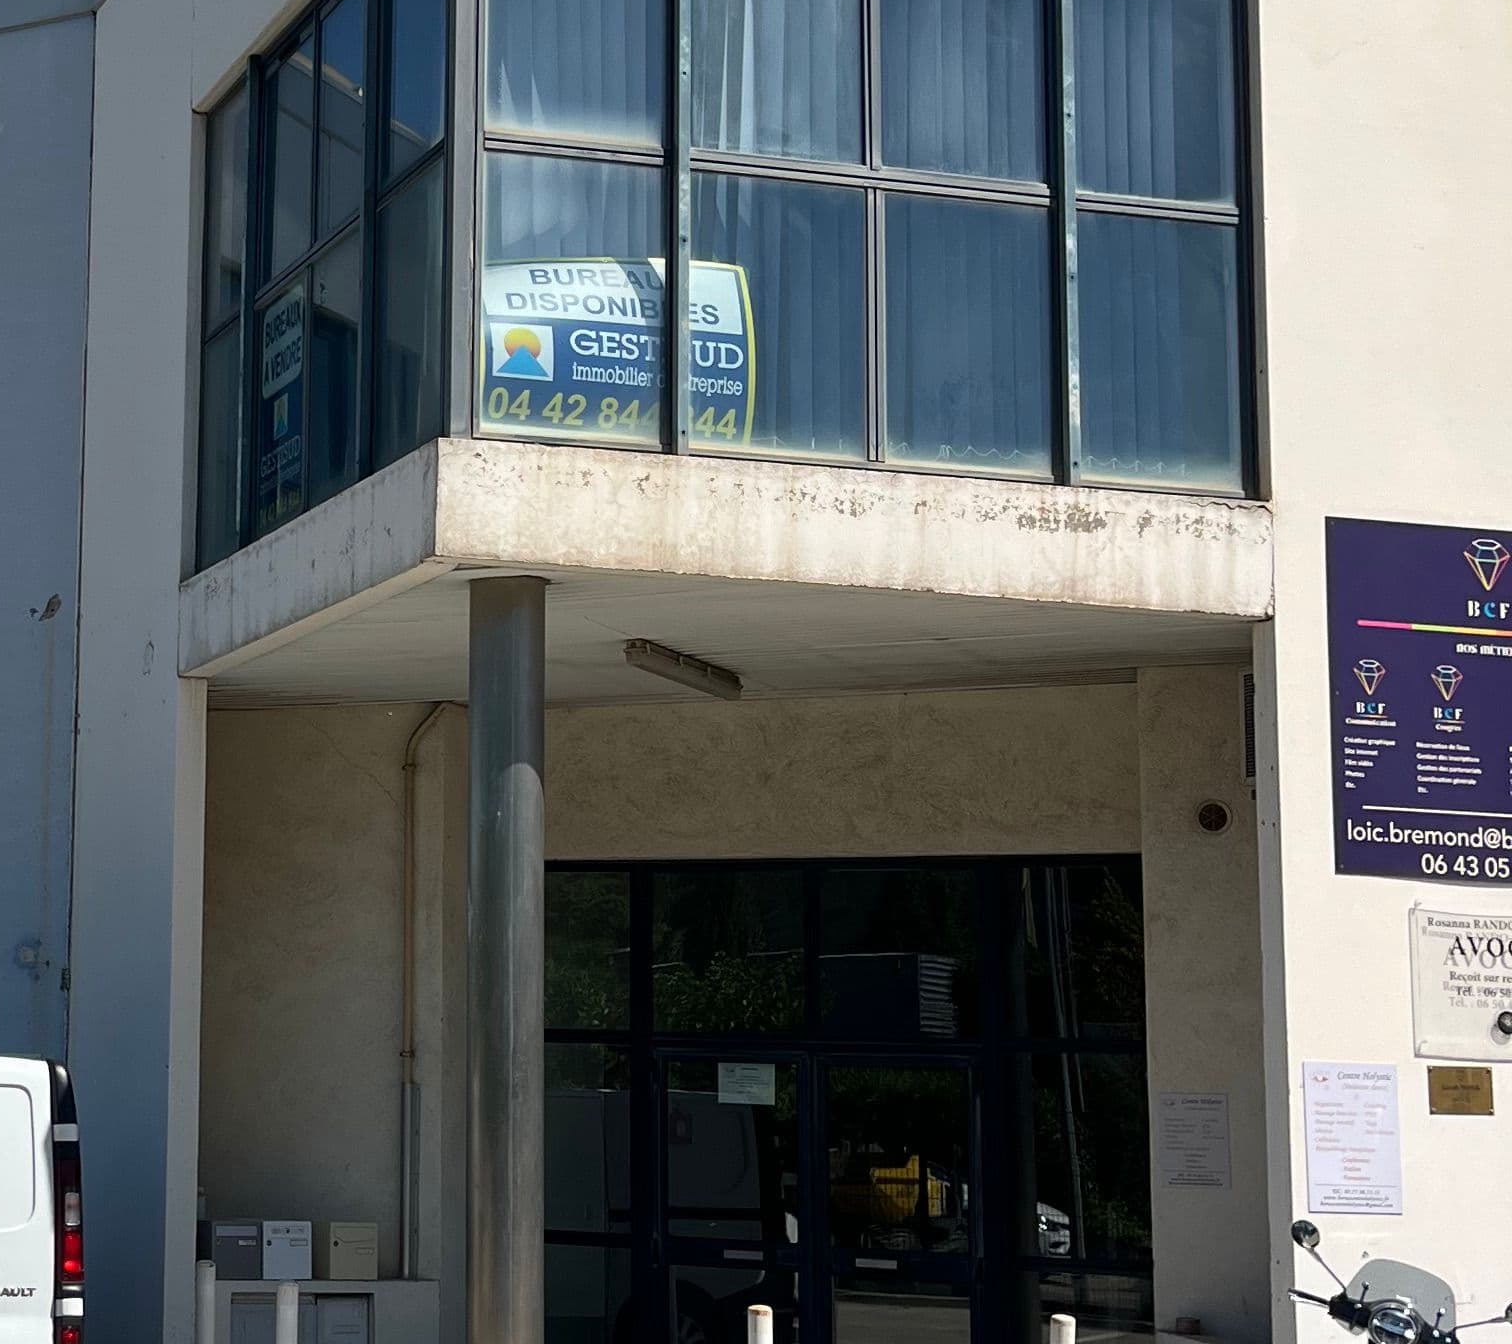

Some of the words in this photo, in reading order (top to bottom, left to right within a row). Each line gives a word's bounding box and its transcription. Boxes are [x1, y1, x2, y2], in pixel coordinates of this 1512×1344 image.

[528, 268, 665, 290] BUREAU
[504, 292, 720, 324] DISPONIBES
[569, 329, 744, 369] GESTUD
[572, 362, 654, 388] immobilier
[488, 387, 531, 421] 04
[542, 392, 588, 426] 42
[1467, 600, 1511, 619] BCF
[1355, 701, 1386, 715] BCF
[1433, 706, 1463, 720] BCF
[1421, 853, 1448, 875] 06
[1453, 855, 1479, 877] 43
[1484, 857, 1511, 878] 05
[1427, 917, 1471, 929] Rosanna
